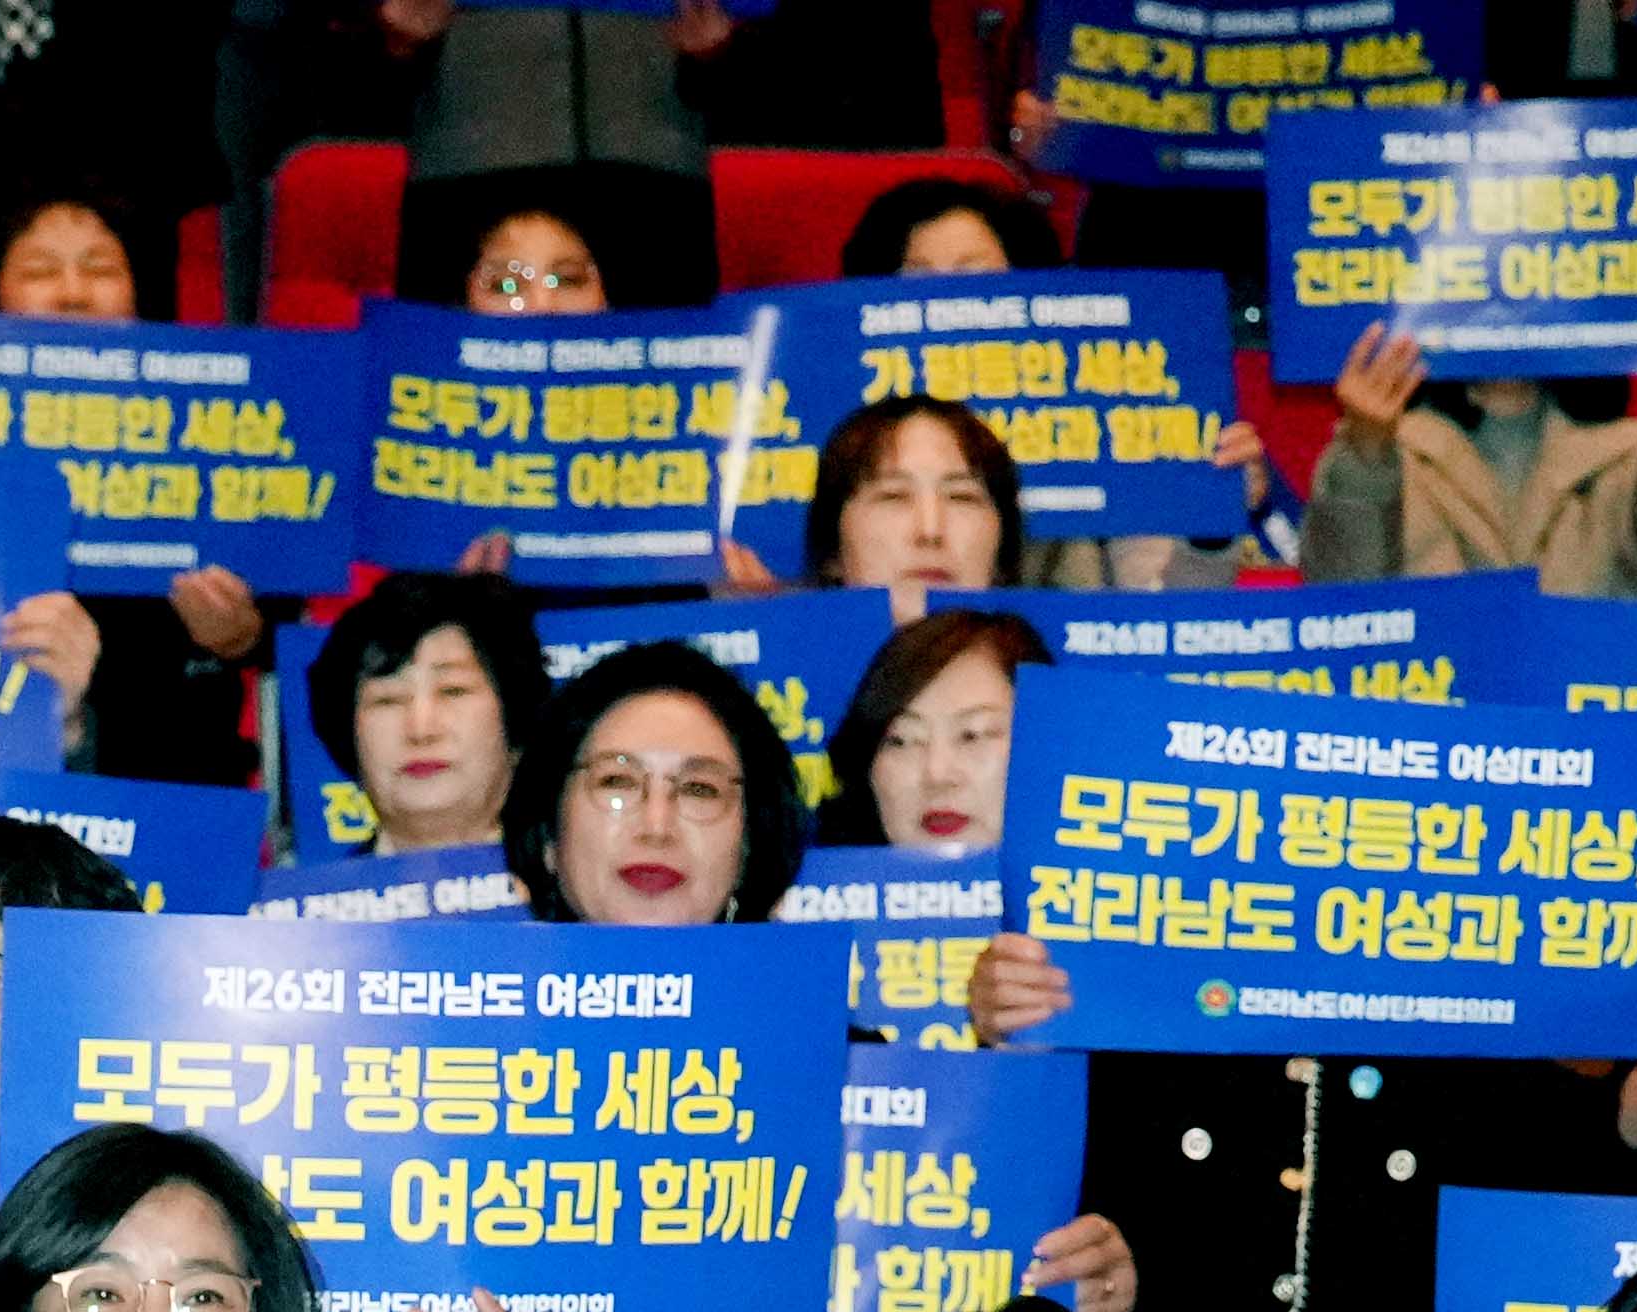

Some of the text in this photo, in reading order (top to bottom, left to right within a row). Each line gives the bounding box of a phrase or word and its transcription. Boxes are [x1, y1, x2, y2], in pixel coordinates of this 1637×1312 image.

[389, 375, 534, 442] 모두가
[1164, 720, 1594, 788] 제26회 전라남도 여성대회
[1054, 774, 1265, 863] 모두가
[1277, 793, 1488, 876] 평등한
[1027, 865, 1296, 953] 전라남도
[1315, 886, 1524, 965] 여성과
[202, 965, 693, 1019] 제26회 전라남도 여성대회
[73, 1038, 754, 1144] 모두가 평등한 세상,
[389, 1156, 808, 1247] 여성과 함께!
